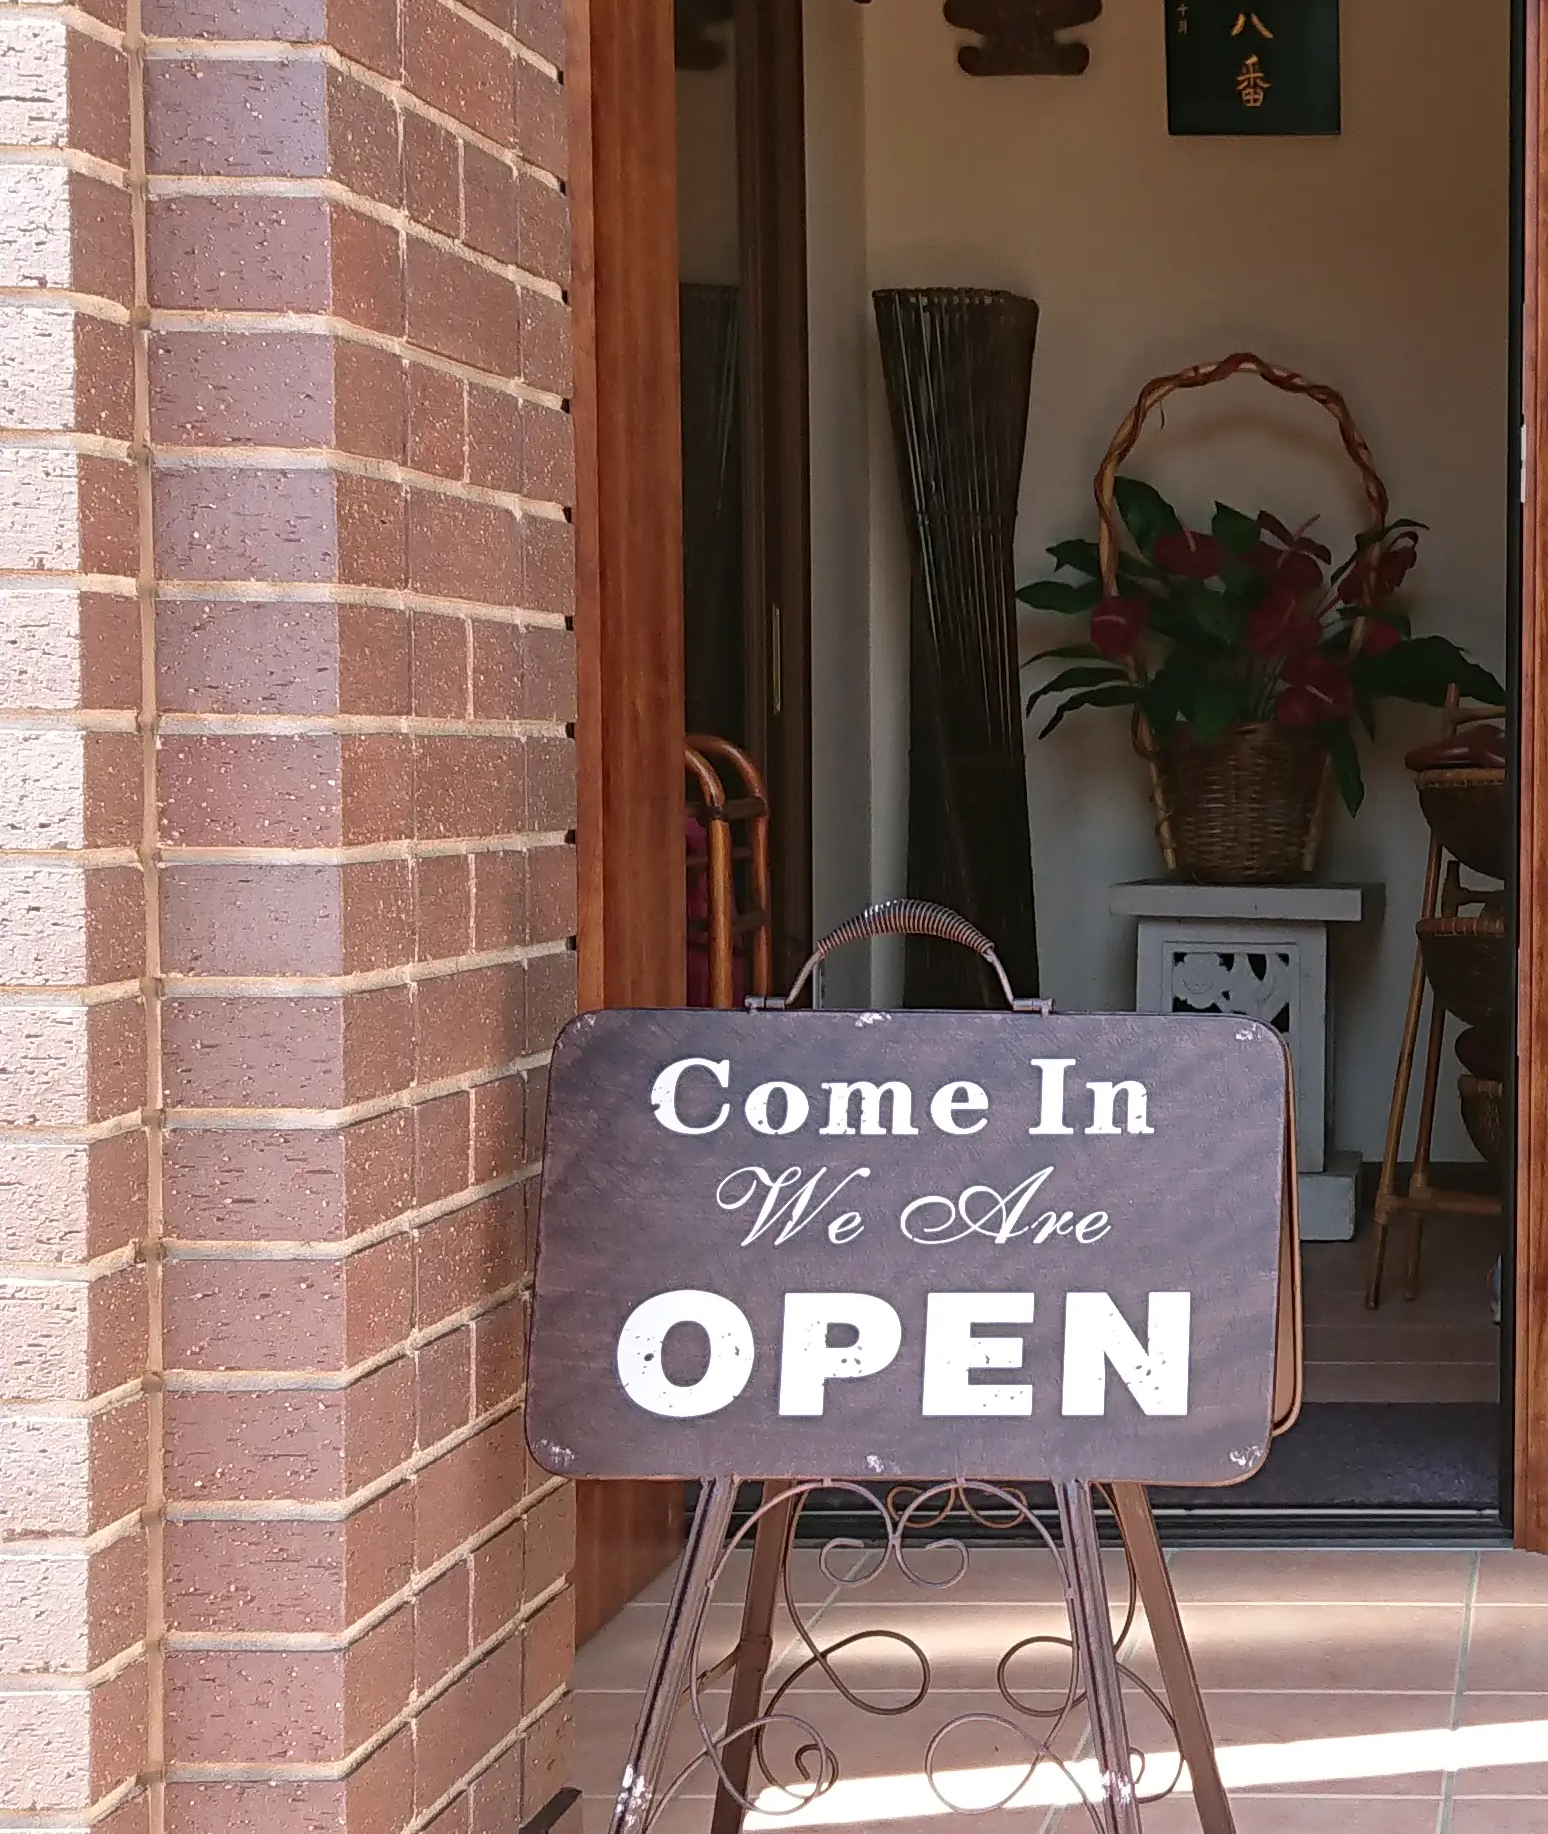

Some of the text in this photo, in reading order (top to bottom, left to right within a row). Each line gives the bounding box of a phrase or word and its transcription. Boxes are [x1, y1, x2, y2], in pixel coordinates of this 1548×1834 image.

[650, 1057, 1155, 1135] Come In
[715, 1165, 1113, 1247] We Are
[615, 1289, 1191, 1418] OPEN
